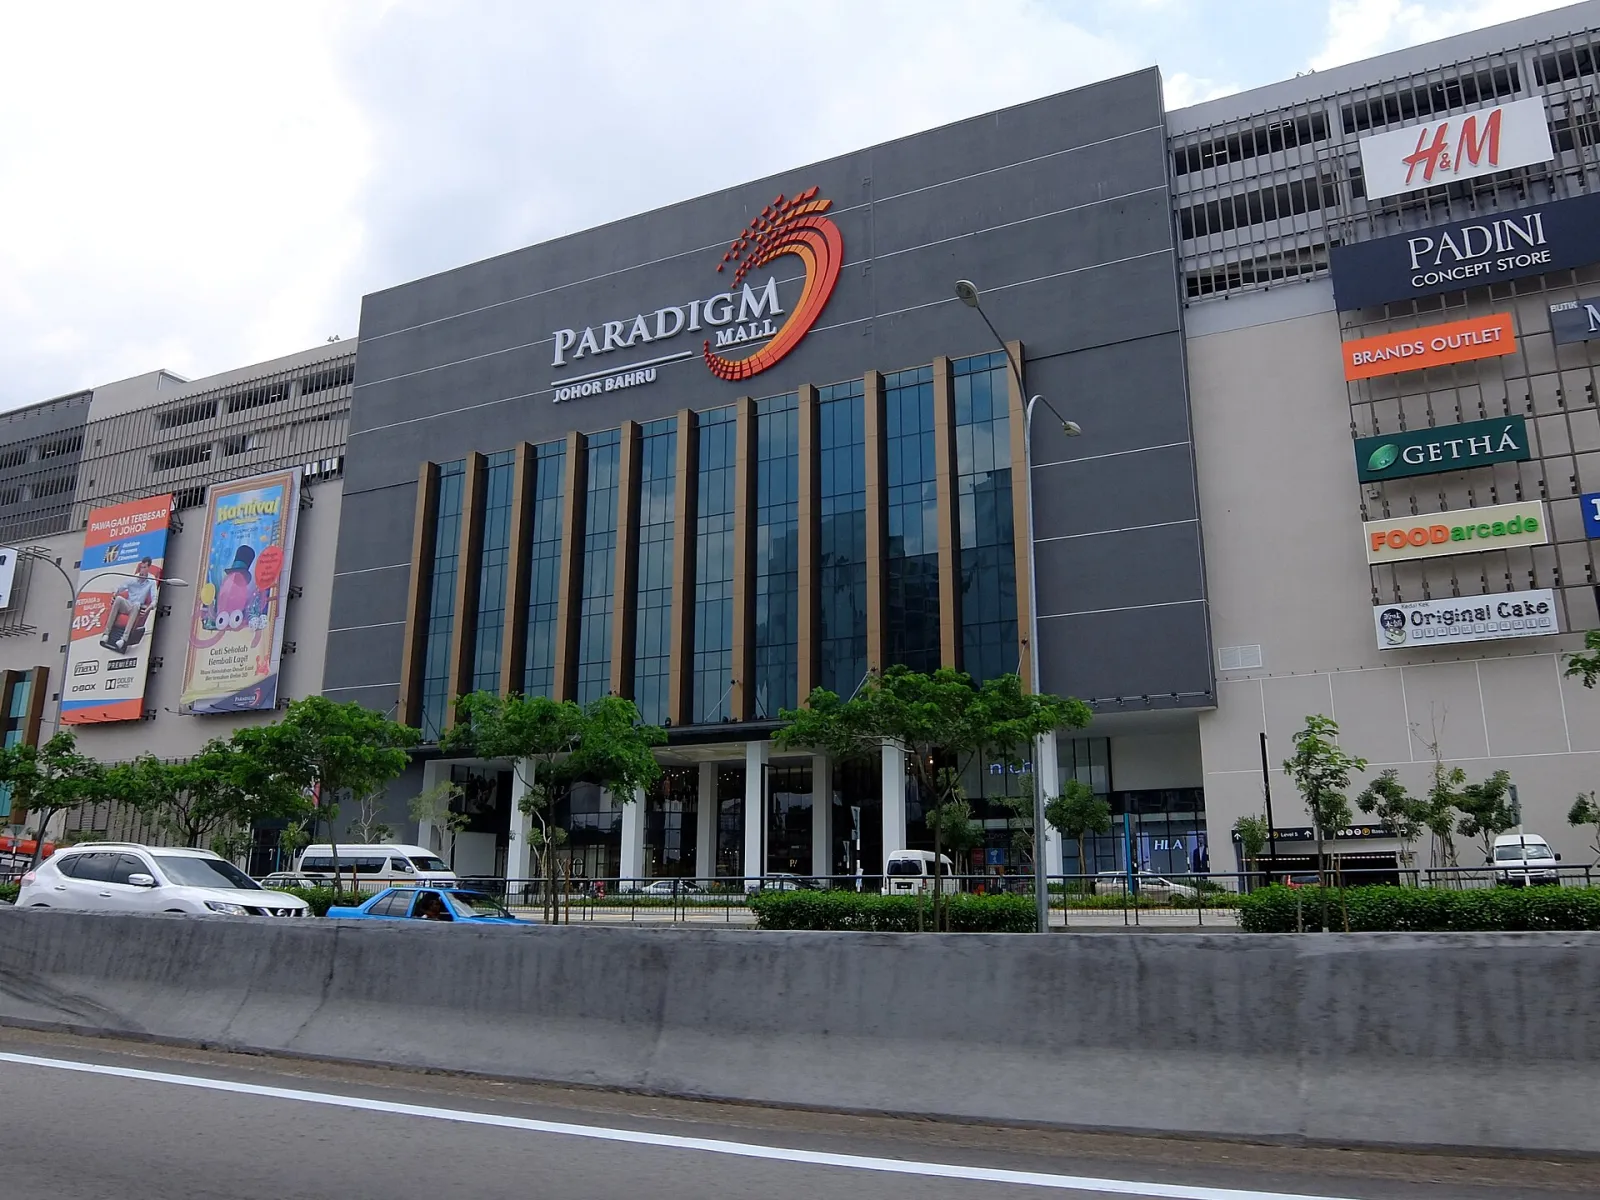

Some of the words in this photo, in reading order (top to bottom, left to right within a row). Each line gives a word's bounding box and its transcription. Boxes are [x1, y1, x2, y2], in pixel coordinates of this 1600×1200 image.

[1402, 108, 1502, 185] H&M
[1407, 212, 1547, 270] PADINI
[1411, 261, 1493, 288] CONCEPT
[1497, 249, 1552, 271] STORE
[551, 276, 785, 367] PARADIGM
[1550, 301, 1578, 313] BUTIK
[715, 318, 778, 348] MALL
[1353, 341, 1426, 366] BRANDS
[1431, 327, 1502, 351] OUTLET
[552, 377, 602, 403] JOHOR
[604, 368, 658, 393] BAHRU
[1402, 425, 1520, 465] GETHÁ
[91, 516, 130, 532] PAWAGAM
[131, 509, 167, 523] TERBESAR
[217, 496, 281, 524] Karnival
[110, 528, 118, 537] DI
[119, 523, 147, 536] JOHOR
[72, 607, 107, 631] 4DX
[1411, 604, 1491, 626] Original
[1497, 600, 1550, 619] Cake
[210, 648, 223, 656] Cuti
[223, 645, 248, 655] Sekolah
[1154, 839, 1183, 850] HLA
